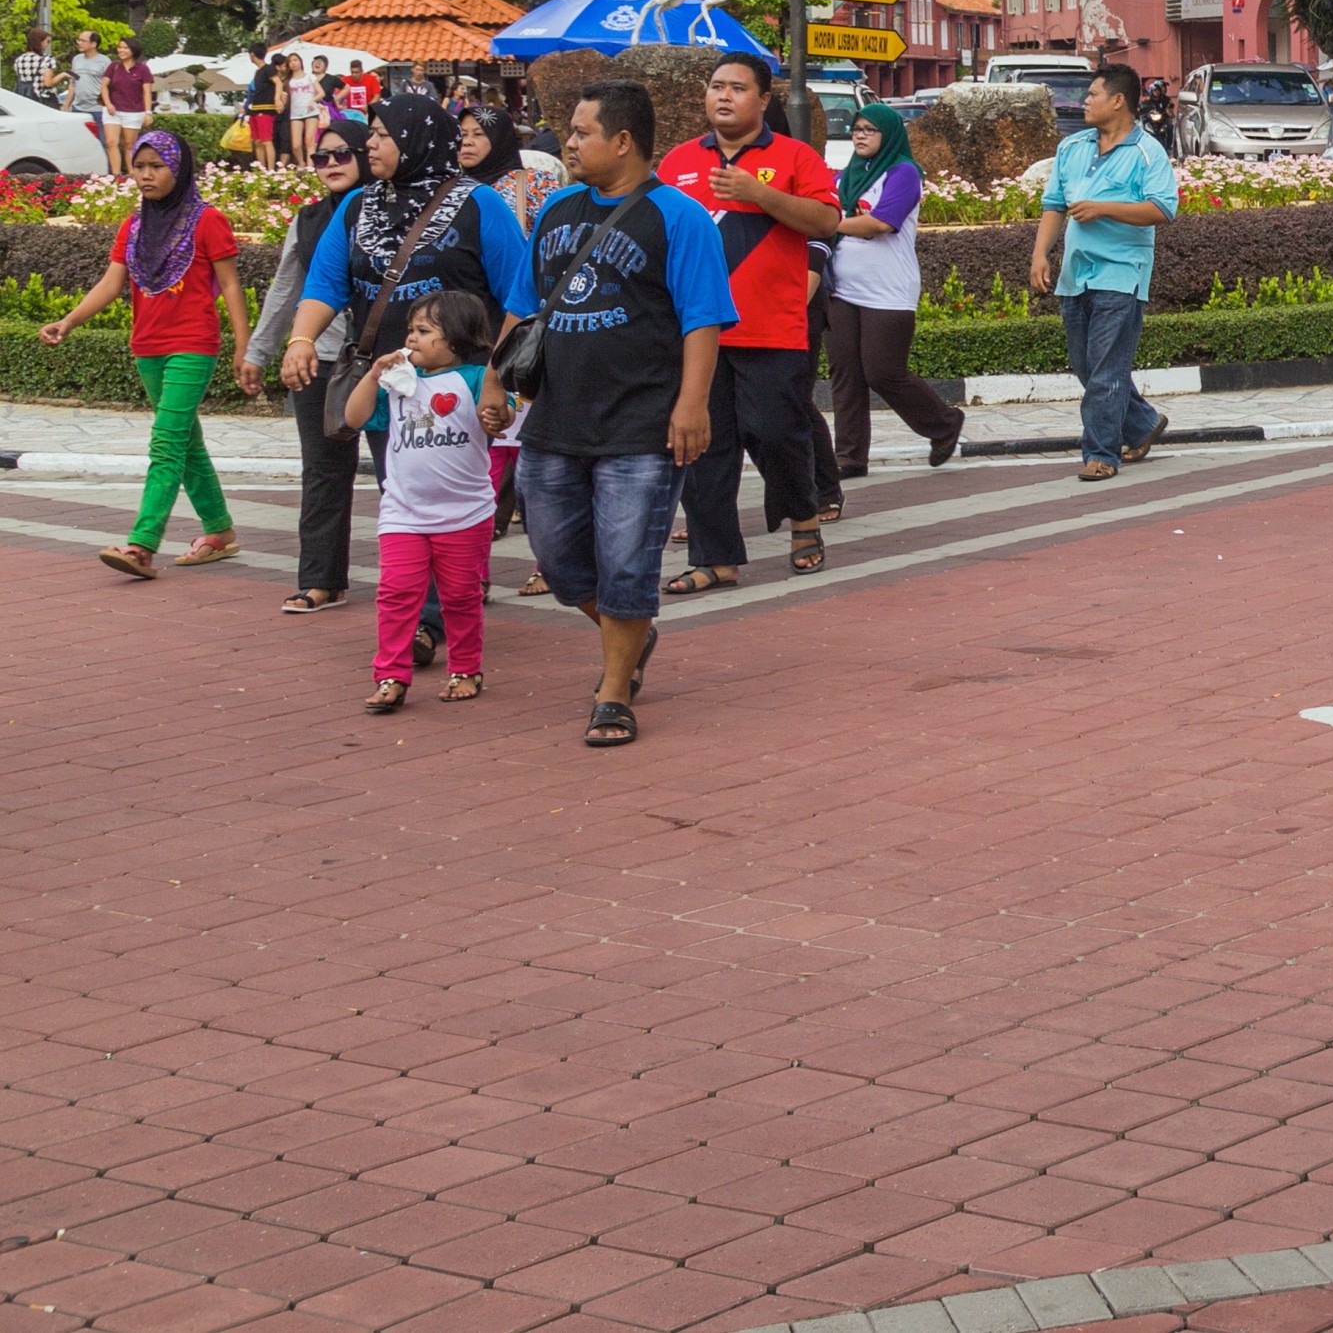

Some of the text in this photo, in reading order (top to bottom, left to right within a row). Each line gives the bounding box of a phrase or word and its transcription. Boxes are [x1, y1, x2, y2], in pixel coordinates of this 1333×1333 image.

[813, 31, 835, 50] HOORN
[837, 33, 860, 52] LISBON
[878, 37, 889, 54] KM
[569, 274, 587, 293] 86
[393, 422, 470, 453] Melaka
